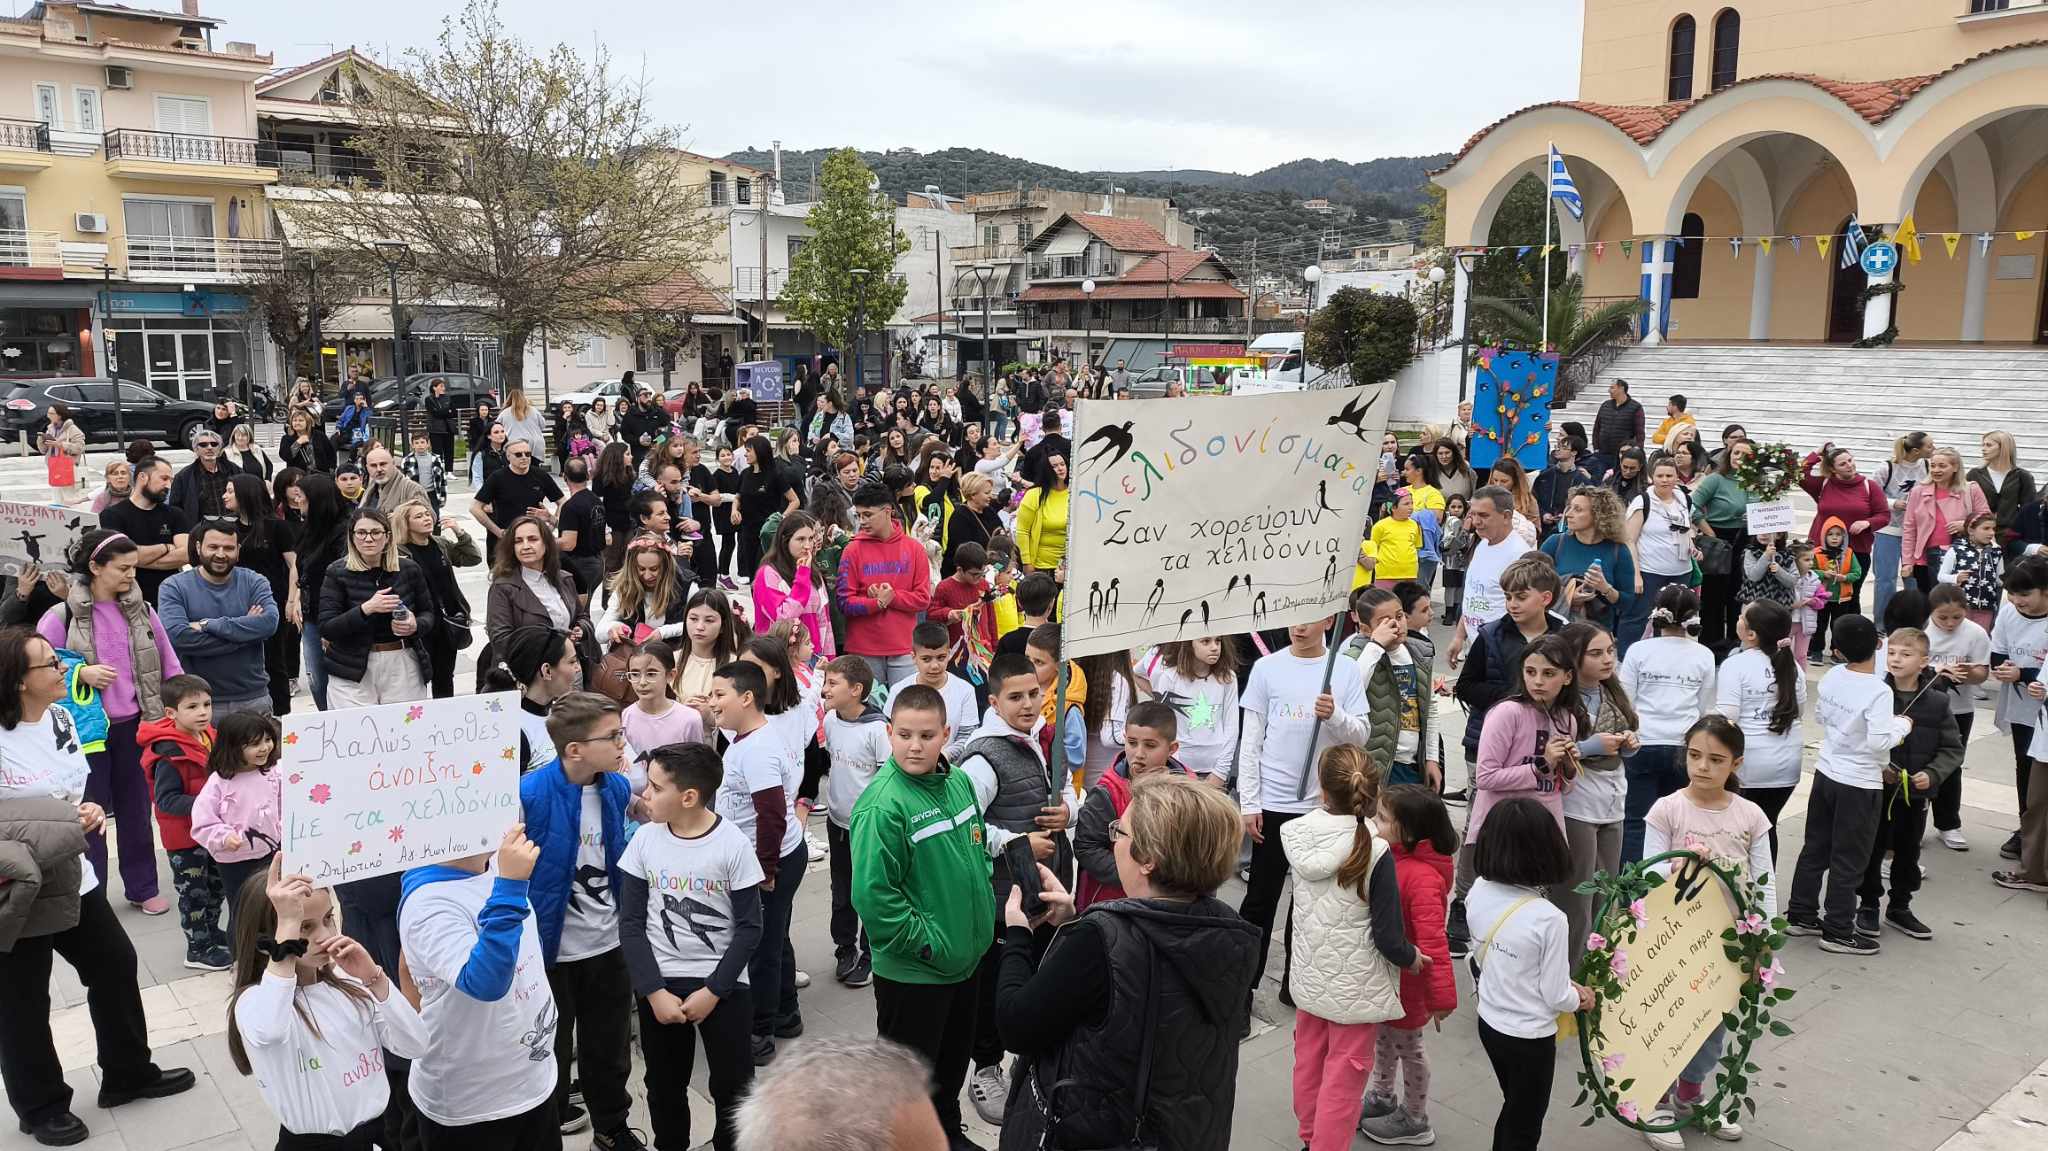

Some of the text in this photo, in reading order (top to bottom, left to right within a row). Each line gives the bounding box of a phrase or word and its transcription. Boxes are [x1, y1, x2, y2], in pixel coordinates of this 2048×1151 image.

[1103, 505, 1322, 549] Σαν χορεύουν
[1160, 530, 1341, 571] τα χελιδόνια
[368, 751, 463, 791] άνοιξη
[290, 779, 515, 852] με τα χελιδόνια
[911, 806, 942, 824] GIVOVA
[1618, 1008, 1638, 1036] δε
[1678, 958, 1688, 969] η
[1668, 996, 1685, 1018] στο
